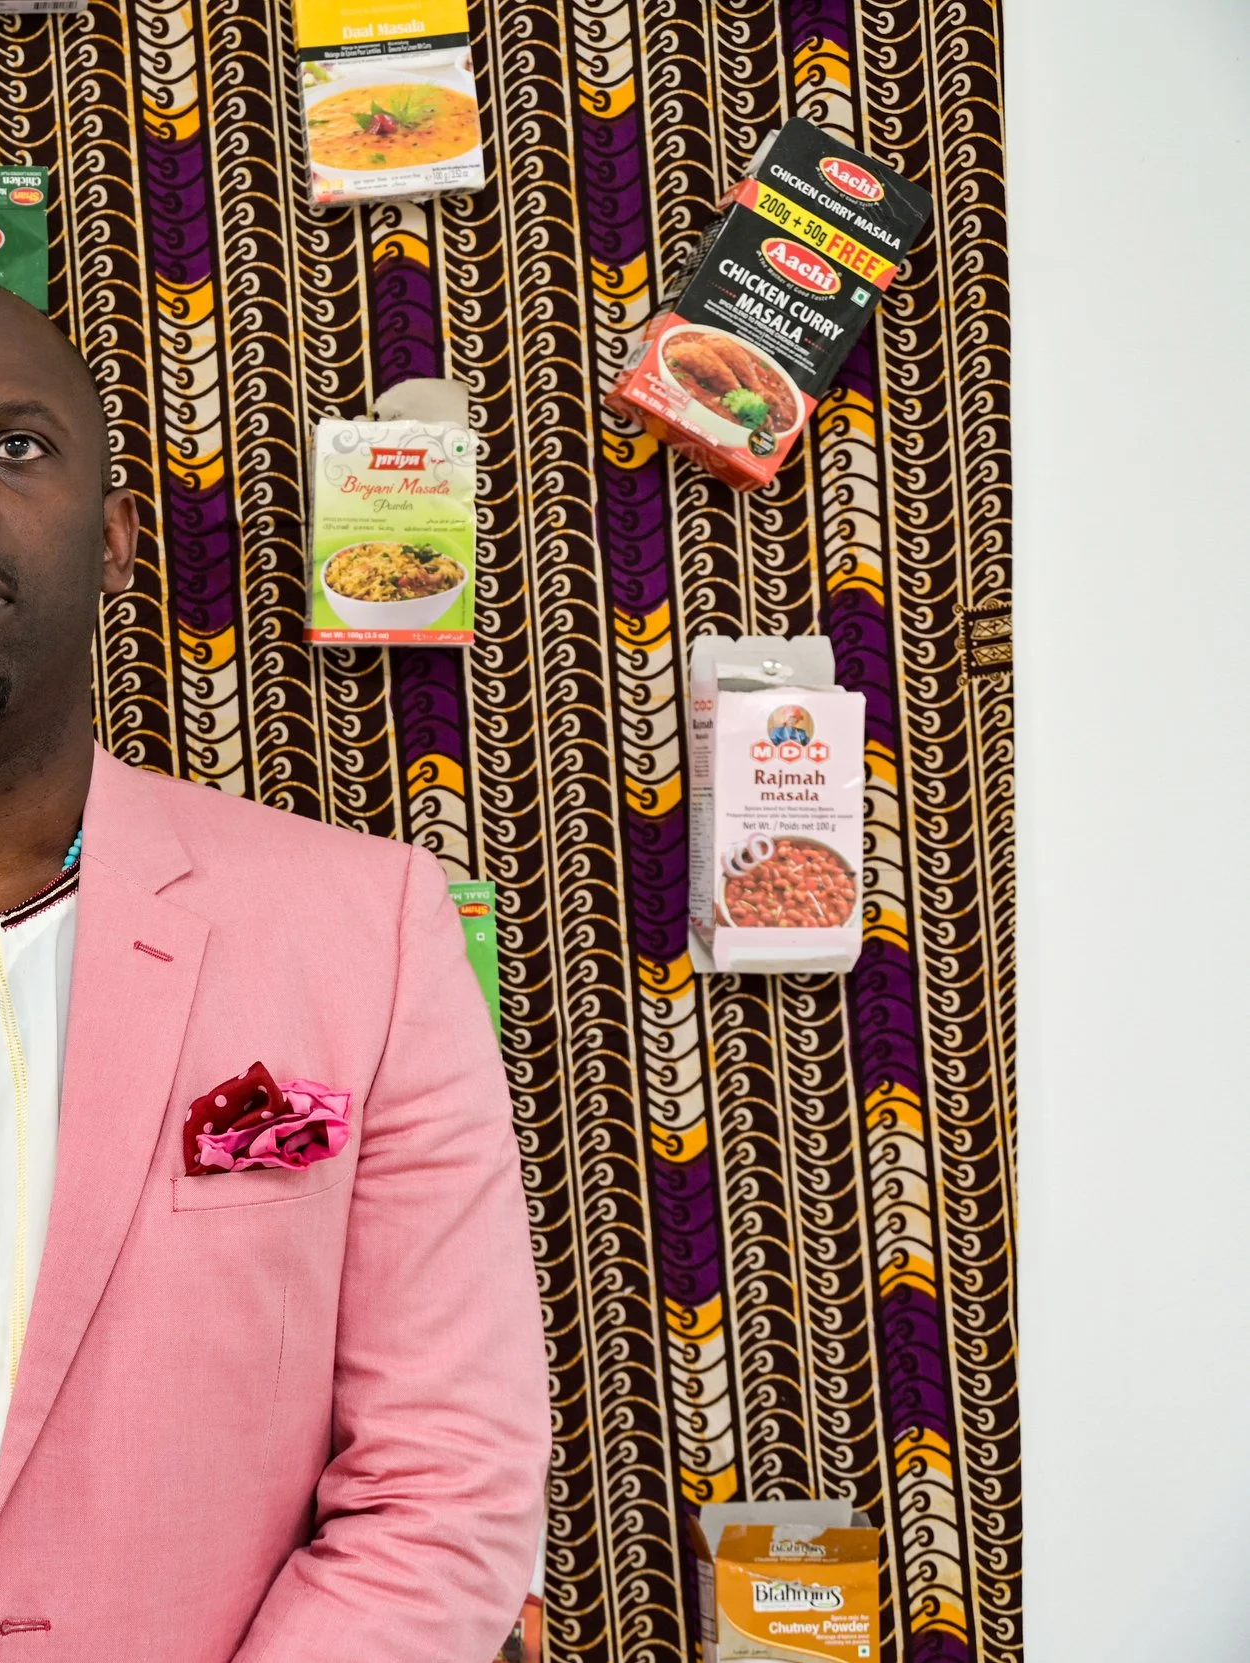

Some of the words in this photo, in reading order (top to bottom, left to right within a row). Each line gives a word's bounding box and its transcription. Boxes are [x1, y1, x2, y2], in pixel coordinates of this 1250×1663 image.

[342, 24, 374, 39] Daal
[378, 19, 425, 35] Masala
[3, 176, 41, 187] Chicken
[824, 161, 878, 198] Aachi
[13, 192, 40, 201] Shan
[770, 164, 819, 200] CHICKEN
[817, 193, 855, 221] CURRY
[854, 214, 901, 250] MASALA
[759, 193, 792, 224] 200g
[793, 216, 802, 229] +
[804, 220, 828, 247] 50g
[768, 243, 839, 291] Aachi
[718, 258, 791, 310] CHICKEN
[789, 301, 845, 342] CURRY
[735, 292, 803, 344] MASALA
[375, 451, 420, 468] priya
[340, 476, 393, 500] Biryani
[398, 478, 450, 495] Masala
[374, 499, 413, 513] Powder
[752, 743, 828, 760] MDH
[754, 769, 826, 788] Rajmah
[760, 789, 819, 801] masala
[743, 822, 756, 830] Net
[758, 822, 772, 830] Wt.
[779, 822, 799, 831] Poids
[816, 822, 830, 831] 100
[463, 891, 490, 900] DAAL
[460, 905, 488, 915] Shan
[756, 1583, 841, 1608] Brahmins
[769, 1622, 820, 1635] Chutney
[823, 1620, 870, 1633] Powder
